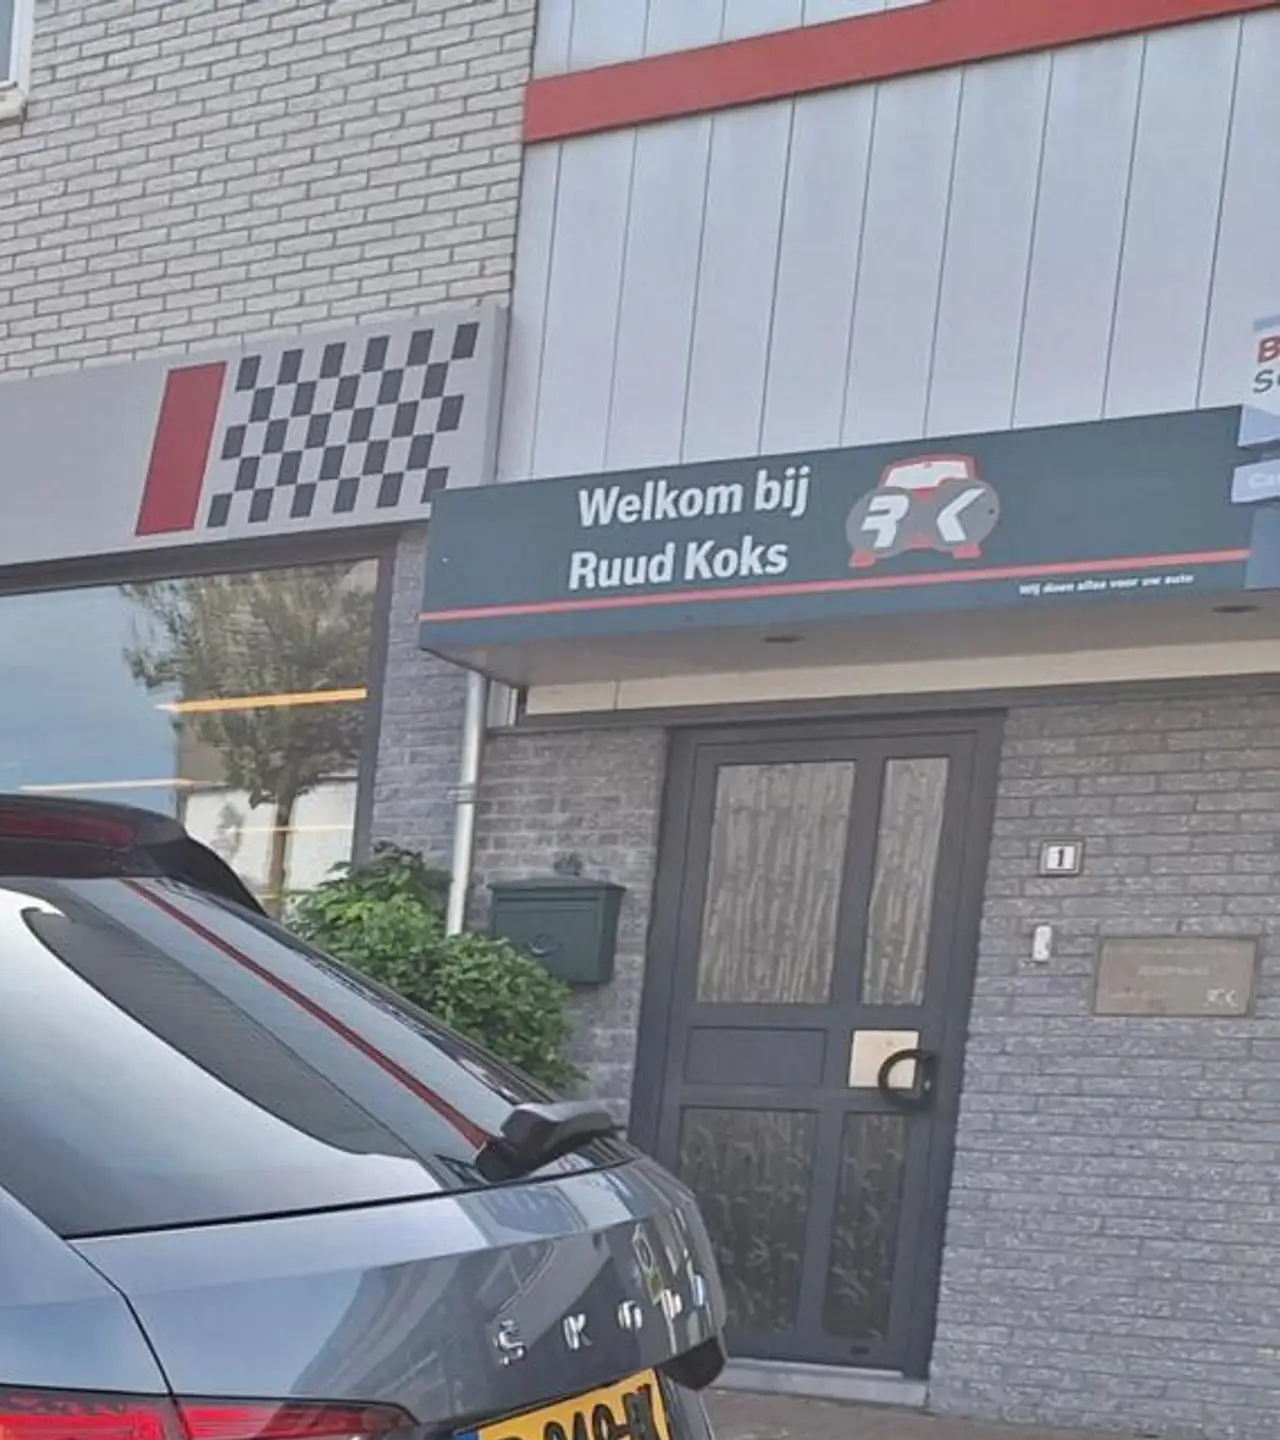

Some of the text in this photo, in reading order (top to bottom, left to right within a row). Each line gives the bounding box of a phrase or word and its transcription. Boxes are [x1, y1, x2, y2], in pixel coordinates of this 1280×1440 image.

[578, 465, 810, 528] Welkom bij
[568, 535, 789, 590] Ruud Koks
[1057, 848, 1066, 868] 1
